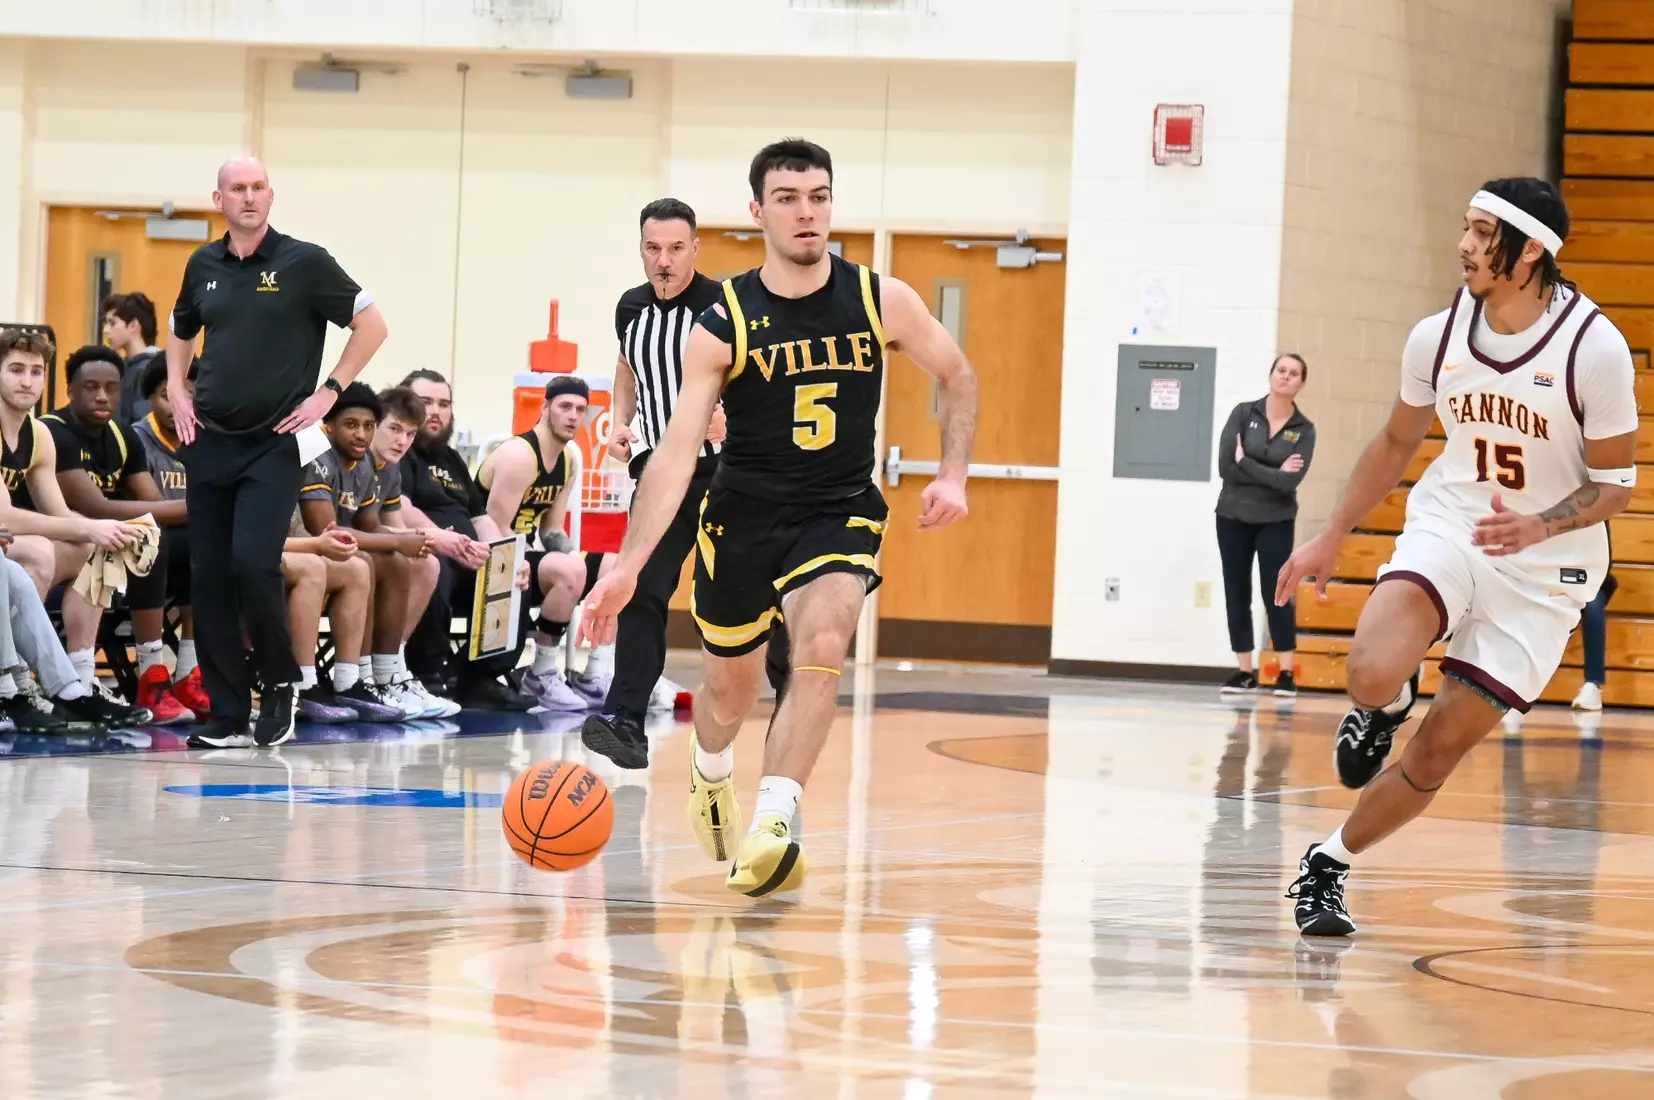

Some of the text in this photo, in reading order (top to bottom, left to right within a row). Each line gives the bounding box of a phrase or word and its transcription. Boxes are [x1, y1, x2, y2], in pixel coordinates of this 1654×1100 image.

[748, 331, 874, 382] VILLE
[1534, 375, 1554, 384] PSAC
[792, 382, 838, 451] 5
[1449, 392, 1549, 441] GANNON
[1474, 437, 1525, 490] 15
